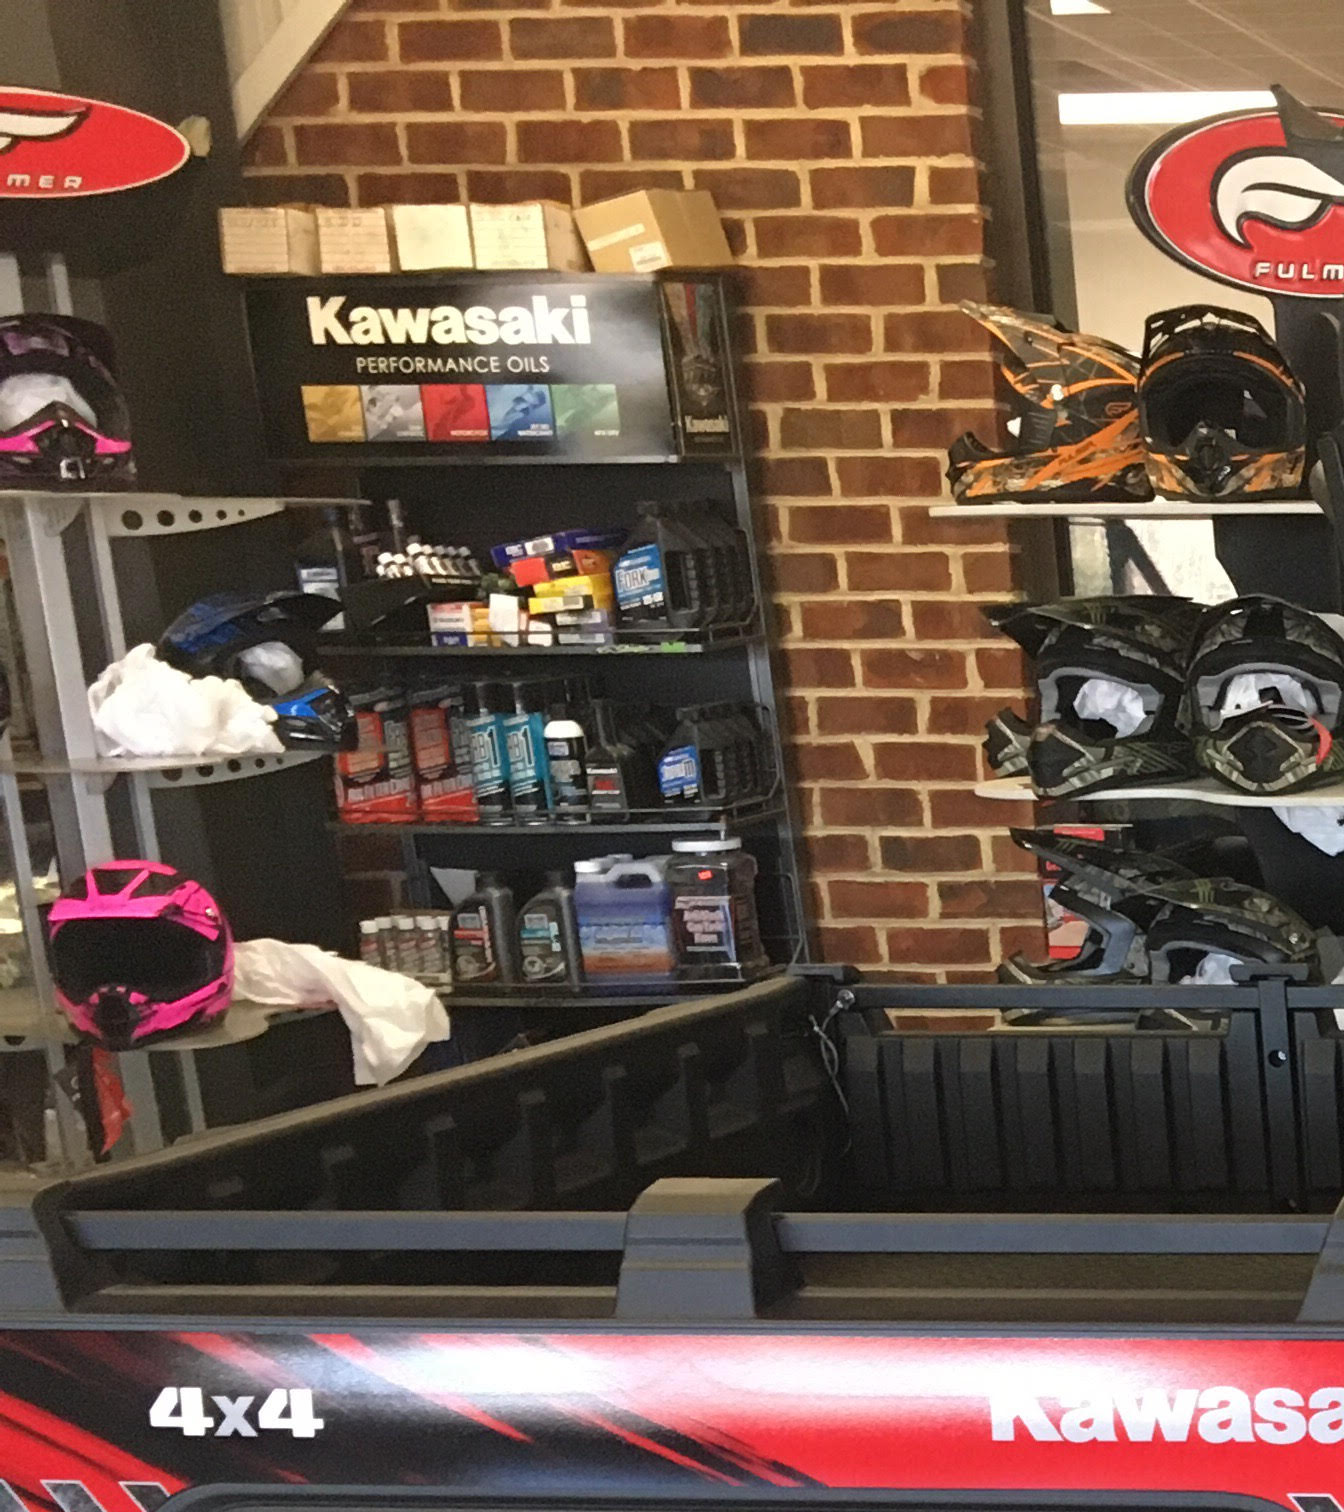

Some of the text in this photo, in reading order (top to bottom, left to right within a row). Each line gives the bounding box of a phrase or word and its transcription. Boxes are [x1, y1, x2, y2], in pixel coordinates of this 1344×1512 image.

[1254, 261, 1344, 281] FULM
[305, 294, 592, 346] Kawasaki
[356, 355, 550, 374] PERFORMANCE OILS
[149, 1386, 325, 1438] 4x4
